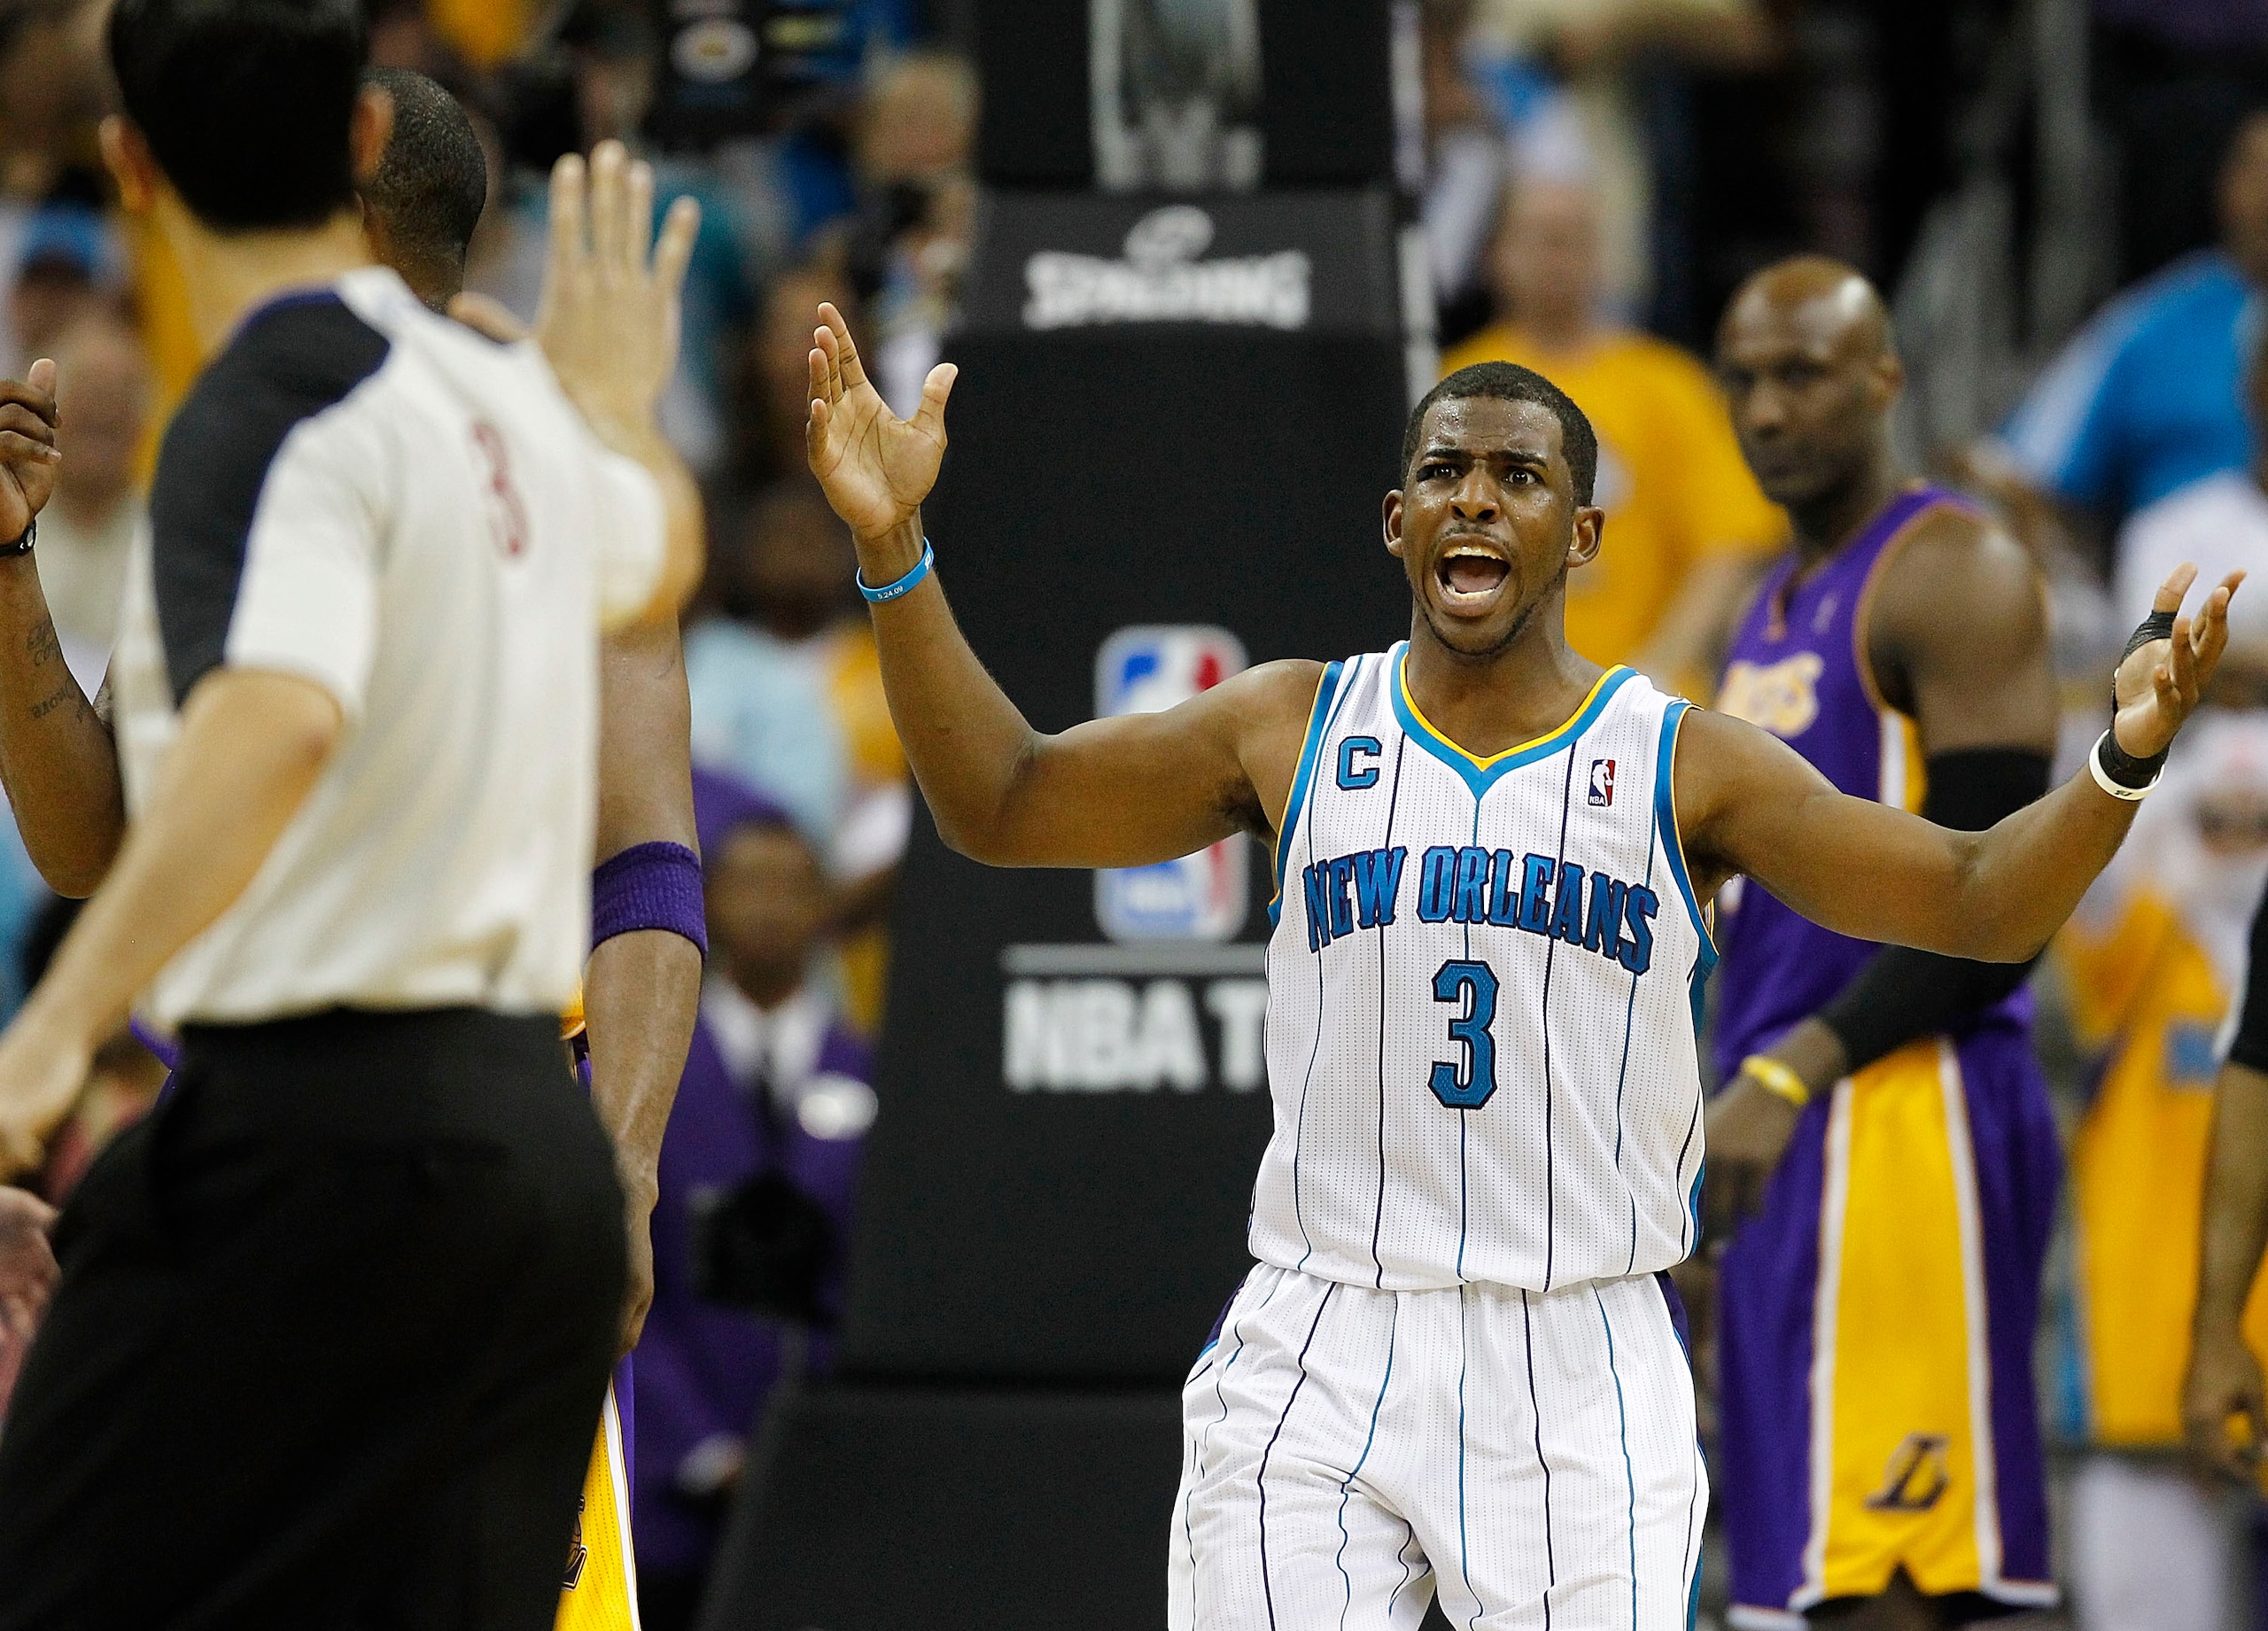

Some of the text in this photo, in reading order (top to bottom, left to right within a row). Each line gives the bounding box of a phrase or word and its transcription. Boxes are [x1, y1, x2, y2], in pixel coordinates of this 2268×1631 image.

[877, 585, 904, 600] 5.24.09
[1336, 735, 1382, 791] C
[1588, 796, 1605, 805] NBA
[1302, 845, 1659, 976] NEW ORLEANS
[1003, 979, 1207, 1092] NBA
[1427, 959, 1500, 1110] 3
